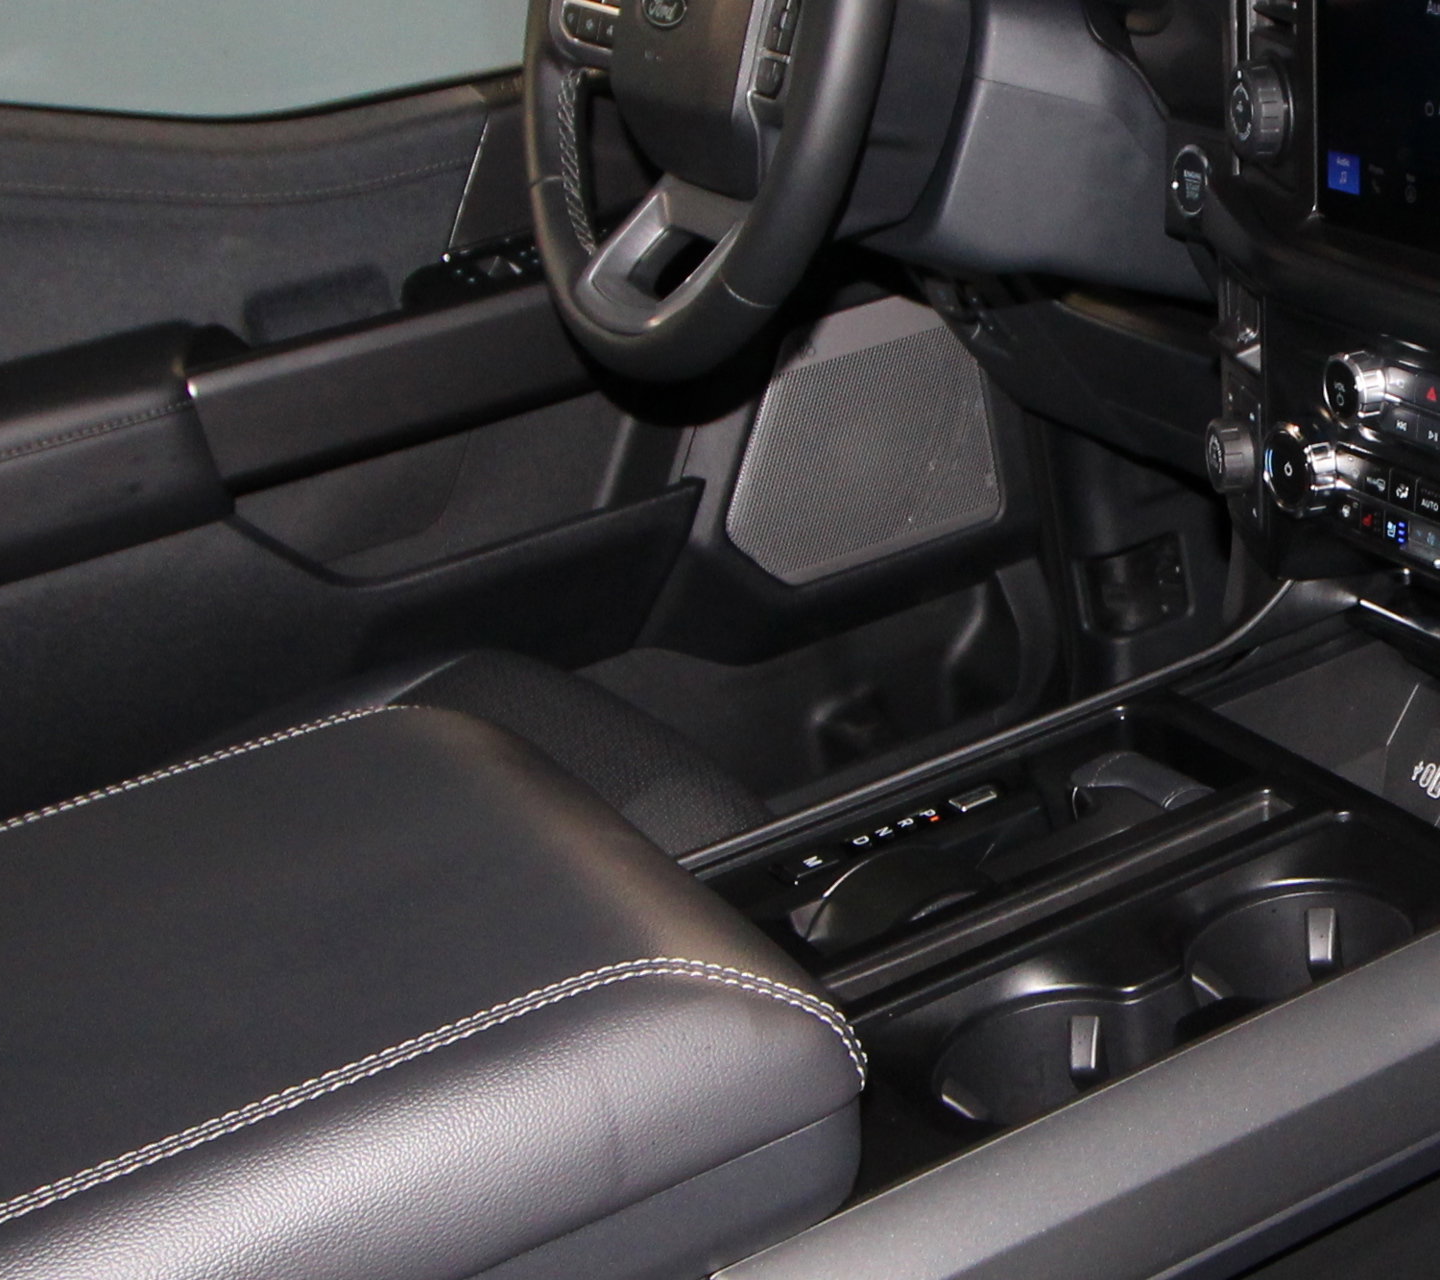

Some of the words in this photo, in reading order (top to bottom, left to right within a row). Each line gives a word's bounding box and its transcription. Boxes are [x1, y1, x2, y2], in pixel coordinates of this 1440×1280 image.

[1334, 382, 1346, 393] VOL
[1421, 498, 1439, 512] AUTO
[919, 808, 936, 818] P
[897, 817, 914, 828] R
[875, 826, 893, 837] N
[852, 835, 869, 846] D
[803, 855, 823, 868] M
